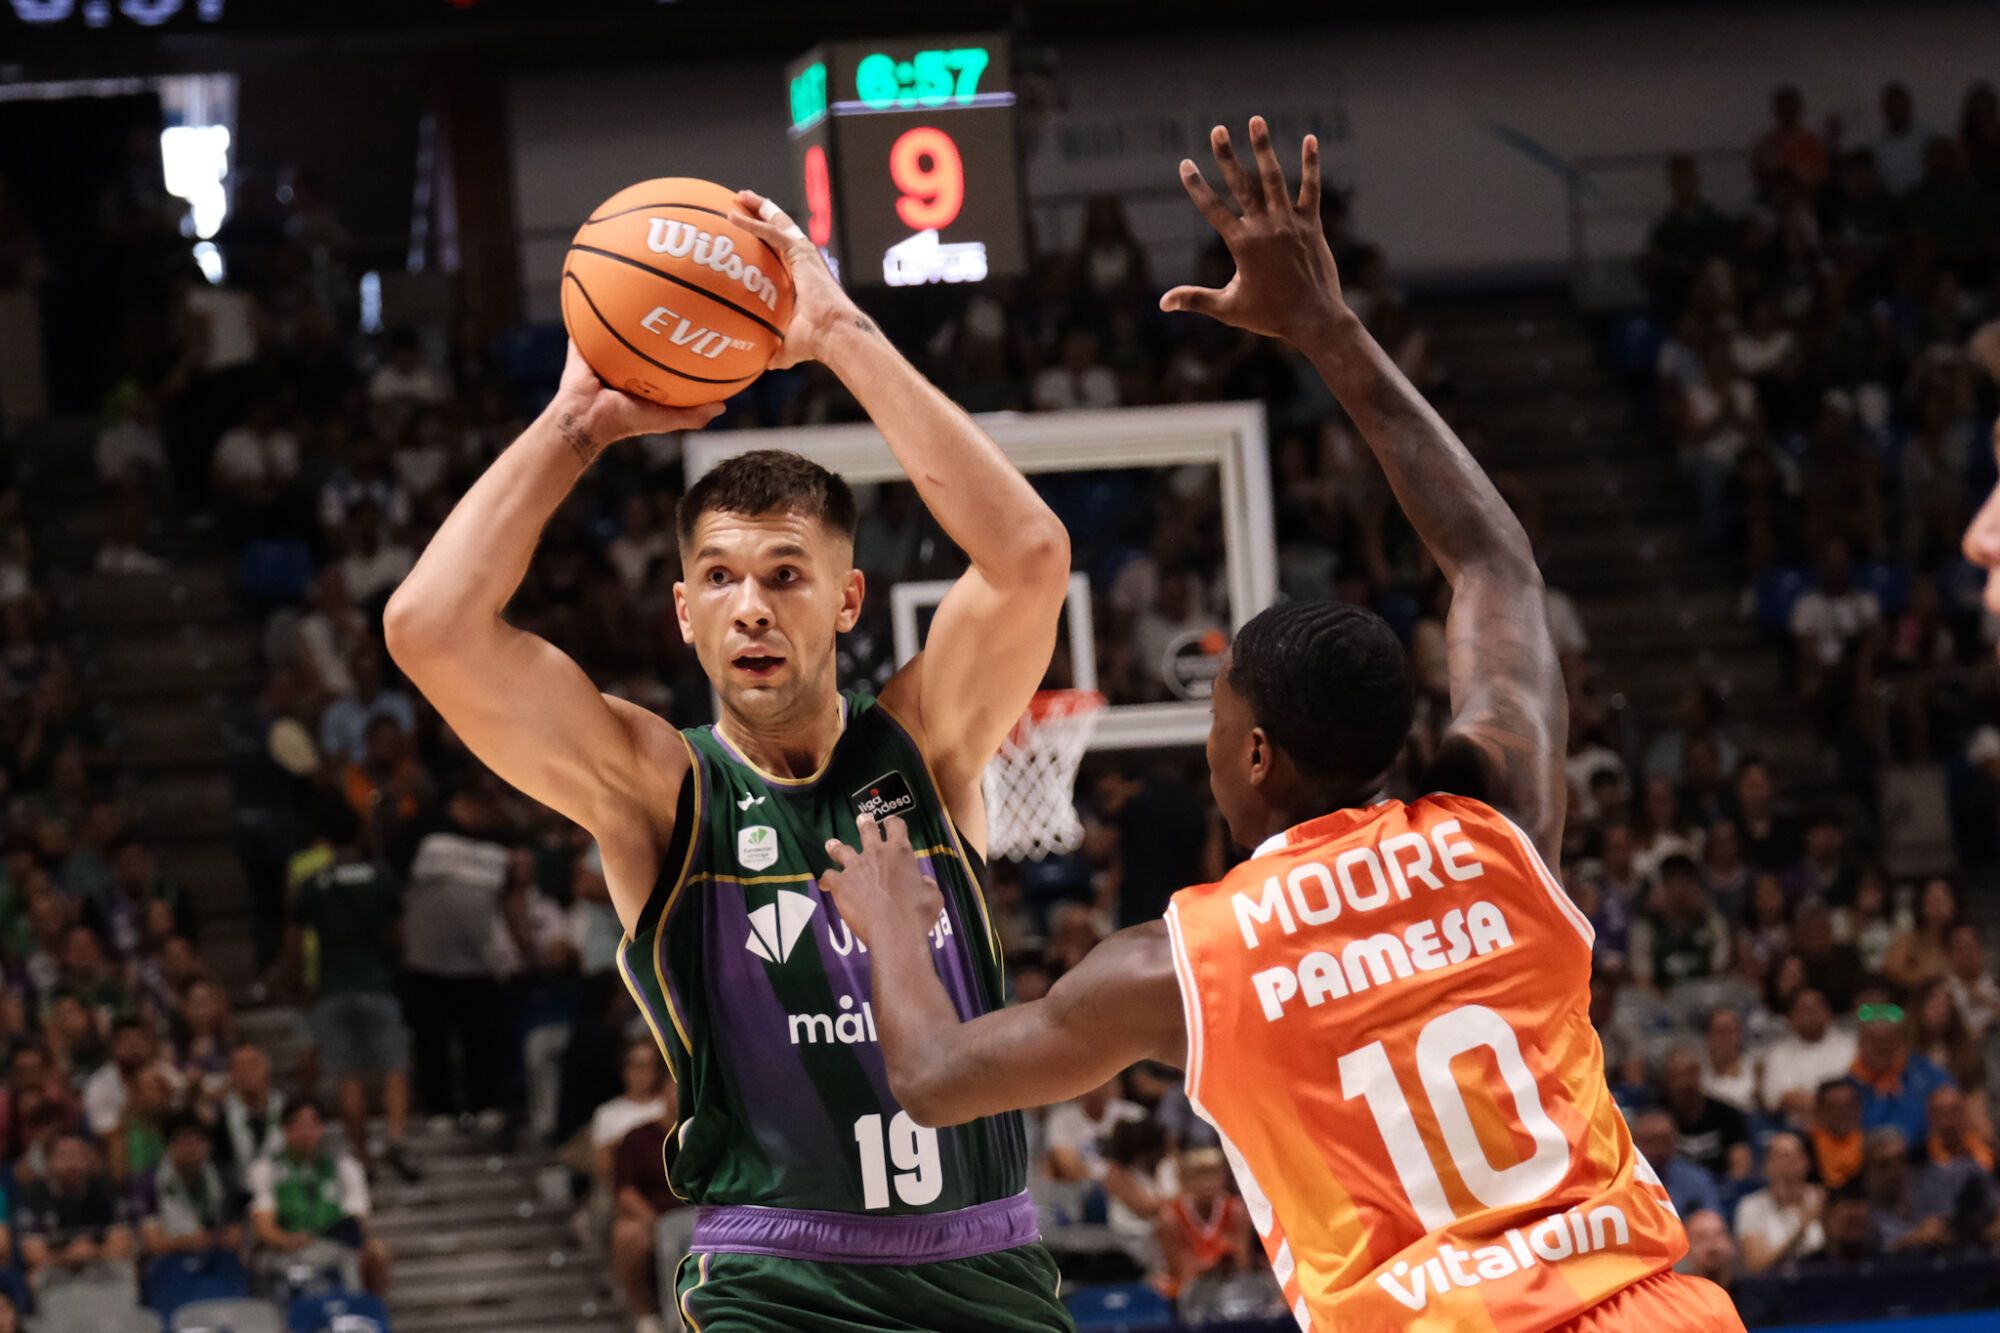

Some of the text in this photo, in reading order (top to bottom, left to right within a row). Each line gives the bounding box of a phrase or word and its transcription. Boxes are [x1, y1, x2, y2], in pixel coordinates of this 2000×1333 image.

[856, 48, 989, 110] 6:57
[889, 126, 965, 231] 9
[647, 217, 778, 312] Wilson
[640, 306, 731, 359] EVO
[858, 795, 882, 813] liga
[1231, 819, 1484, 950] MOORE
[1252, 901, 1514, 1022] PAMESA
[854, 1109, 943, 1209] 19
[1337, 1004, 1570, 1233] 10
